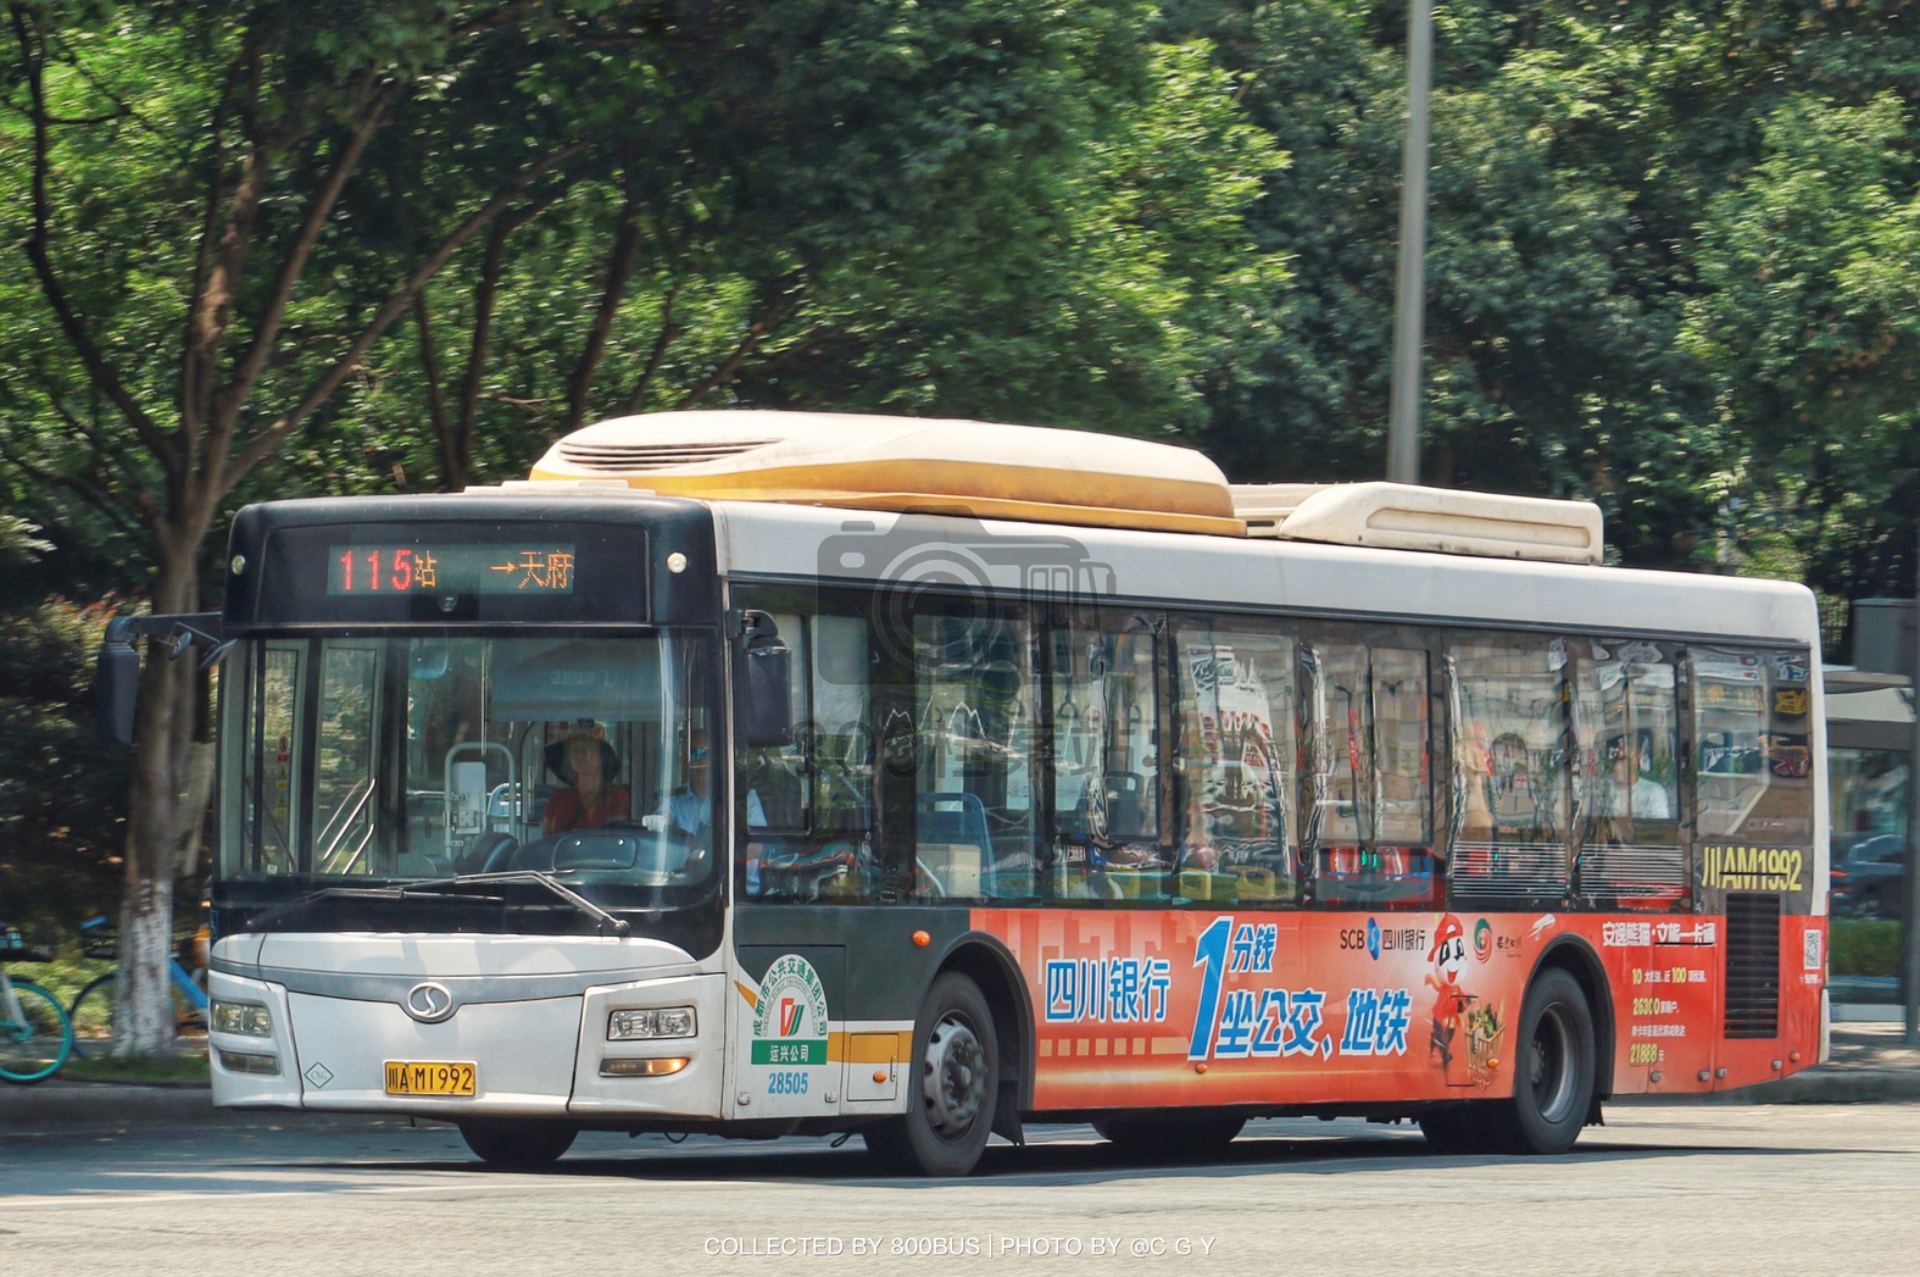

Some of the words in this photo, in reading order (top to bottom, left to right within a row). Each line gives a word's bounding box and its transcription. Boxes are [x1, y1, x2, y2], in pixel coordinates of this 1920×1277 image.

[341, 549, 413, 590] 115
[518, 550, 575, 589] 天府
[1702, 846, 1802, 891] 川AM1992
[1229, 924, 1277, 972] 分钱
[1340, 929, 1365, 950] SCB
[1382, 929, 1426, 951] 四川银行
[1045, 957, 1171, 1023] 四川银行
[769, 1045, 809, 1062] 运兴公司
[767, 1072, 809, 1094] 28505
